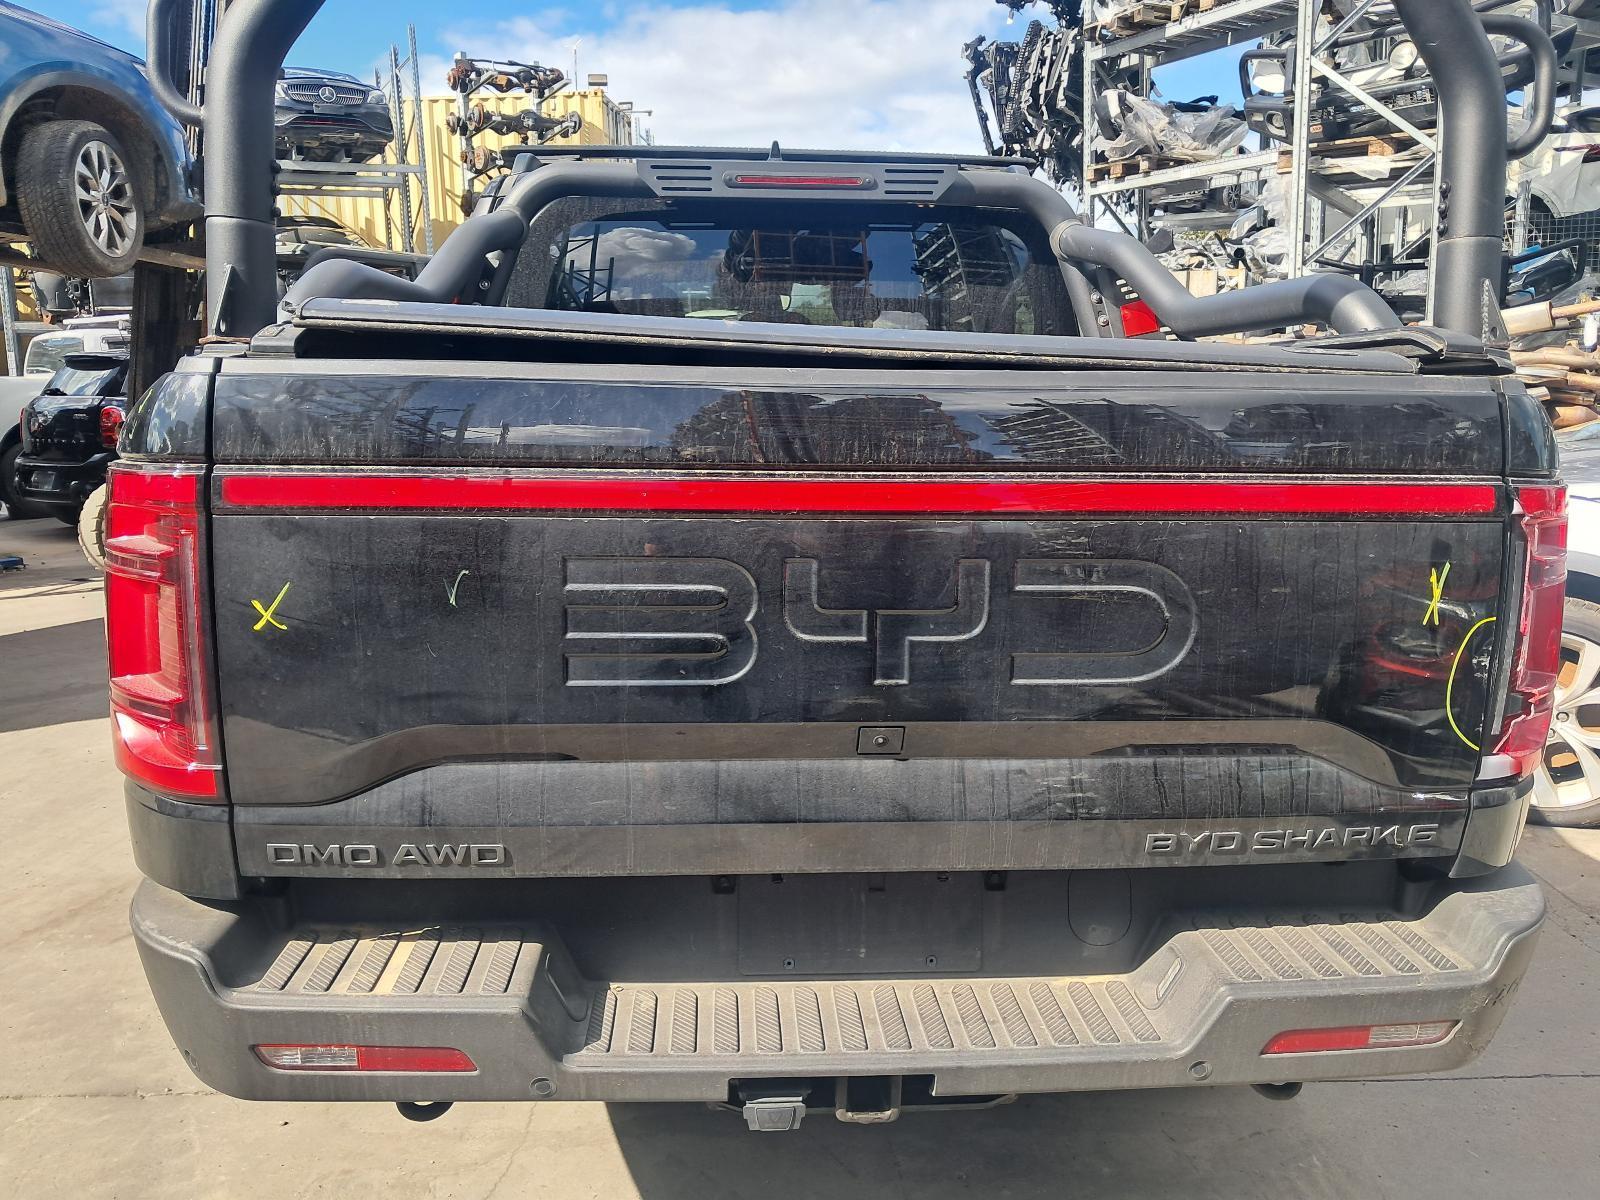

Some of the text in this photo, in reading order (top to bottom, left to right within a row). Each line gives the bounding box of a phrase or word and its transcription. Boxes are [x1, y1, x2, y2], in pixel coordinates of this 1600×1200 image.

[563, 557, 1198, 687] BYD
[1145, 823, 1439, 853] BYD SHARK 6
[266, 843, 507, 866] DMO AWD
